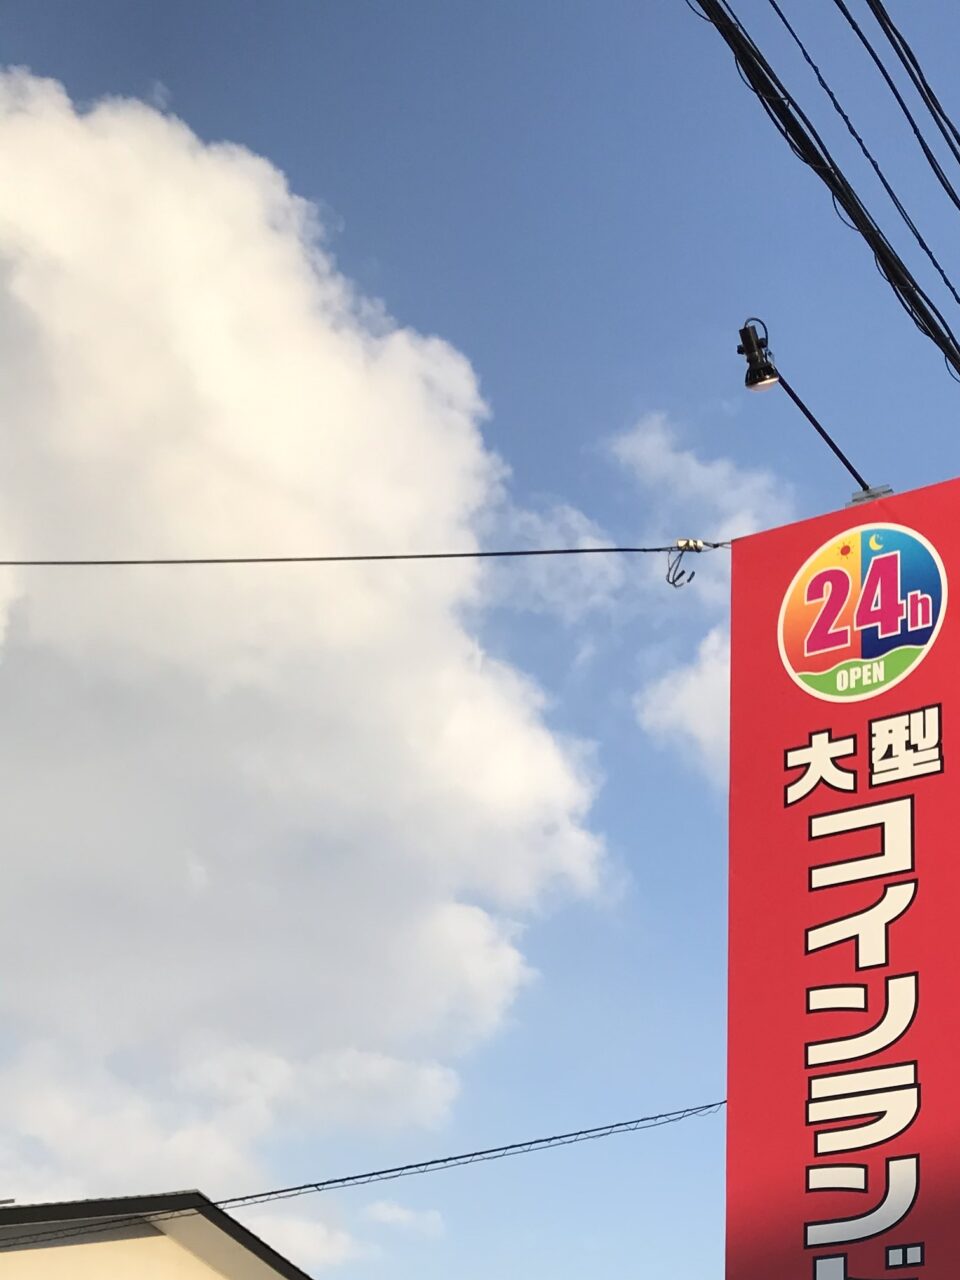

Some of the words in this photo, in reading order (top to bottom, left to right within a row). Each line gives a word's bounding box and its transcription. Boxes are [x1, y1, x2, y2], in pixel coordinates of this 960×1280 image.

[804, 550, 933, 657] 24h
[836, 660, 885, 692] OPEN
[784, 702, 944, 808] 大型
